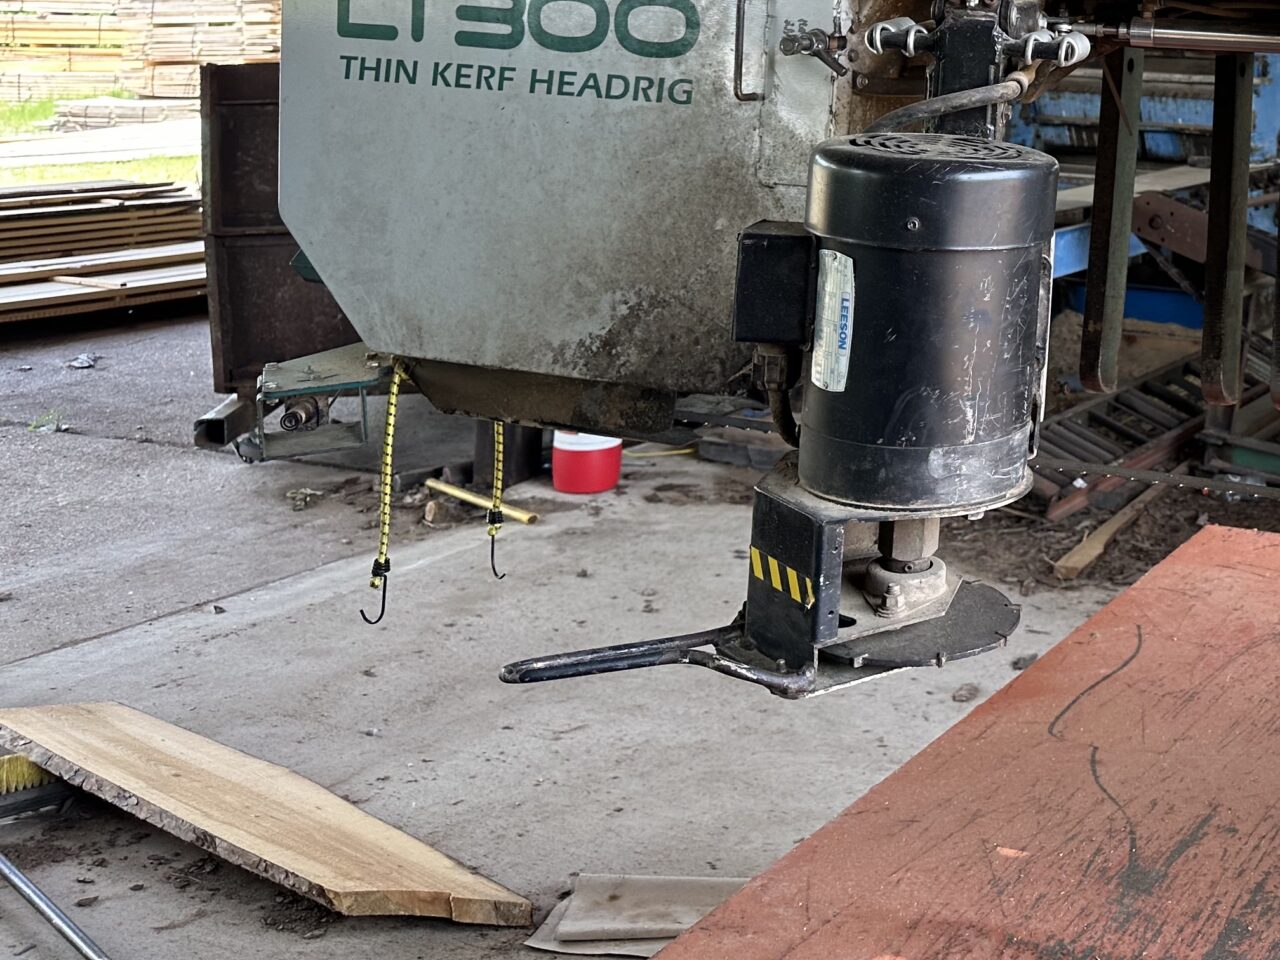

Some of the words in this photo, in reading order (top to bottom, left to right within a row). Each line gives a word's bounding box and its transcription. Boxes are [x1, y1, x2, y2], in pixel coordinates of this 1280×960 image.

[339, 55, 418, 85] THIN
[431, 61, 517, 92] KERF
[529, 69, 693, 105] HEADRIG
[837, 297, 850, 350] LEESON
